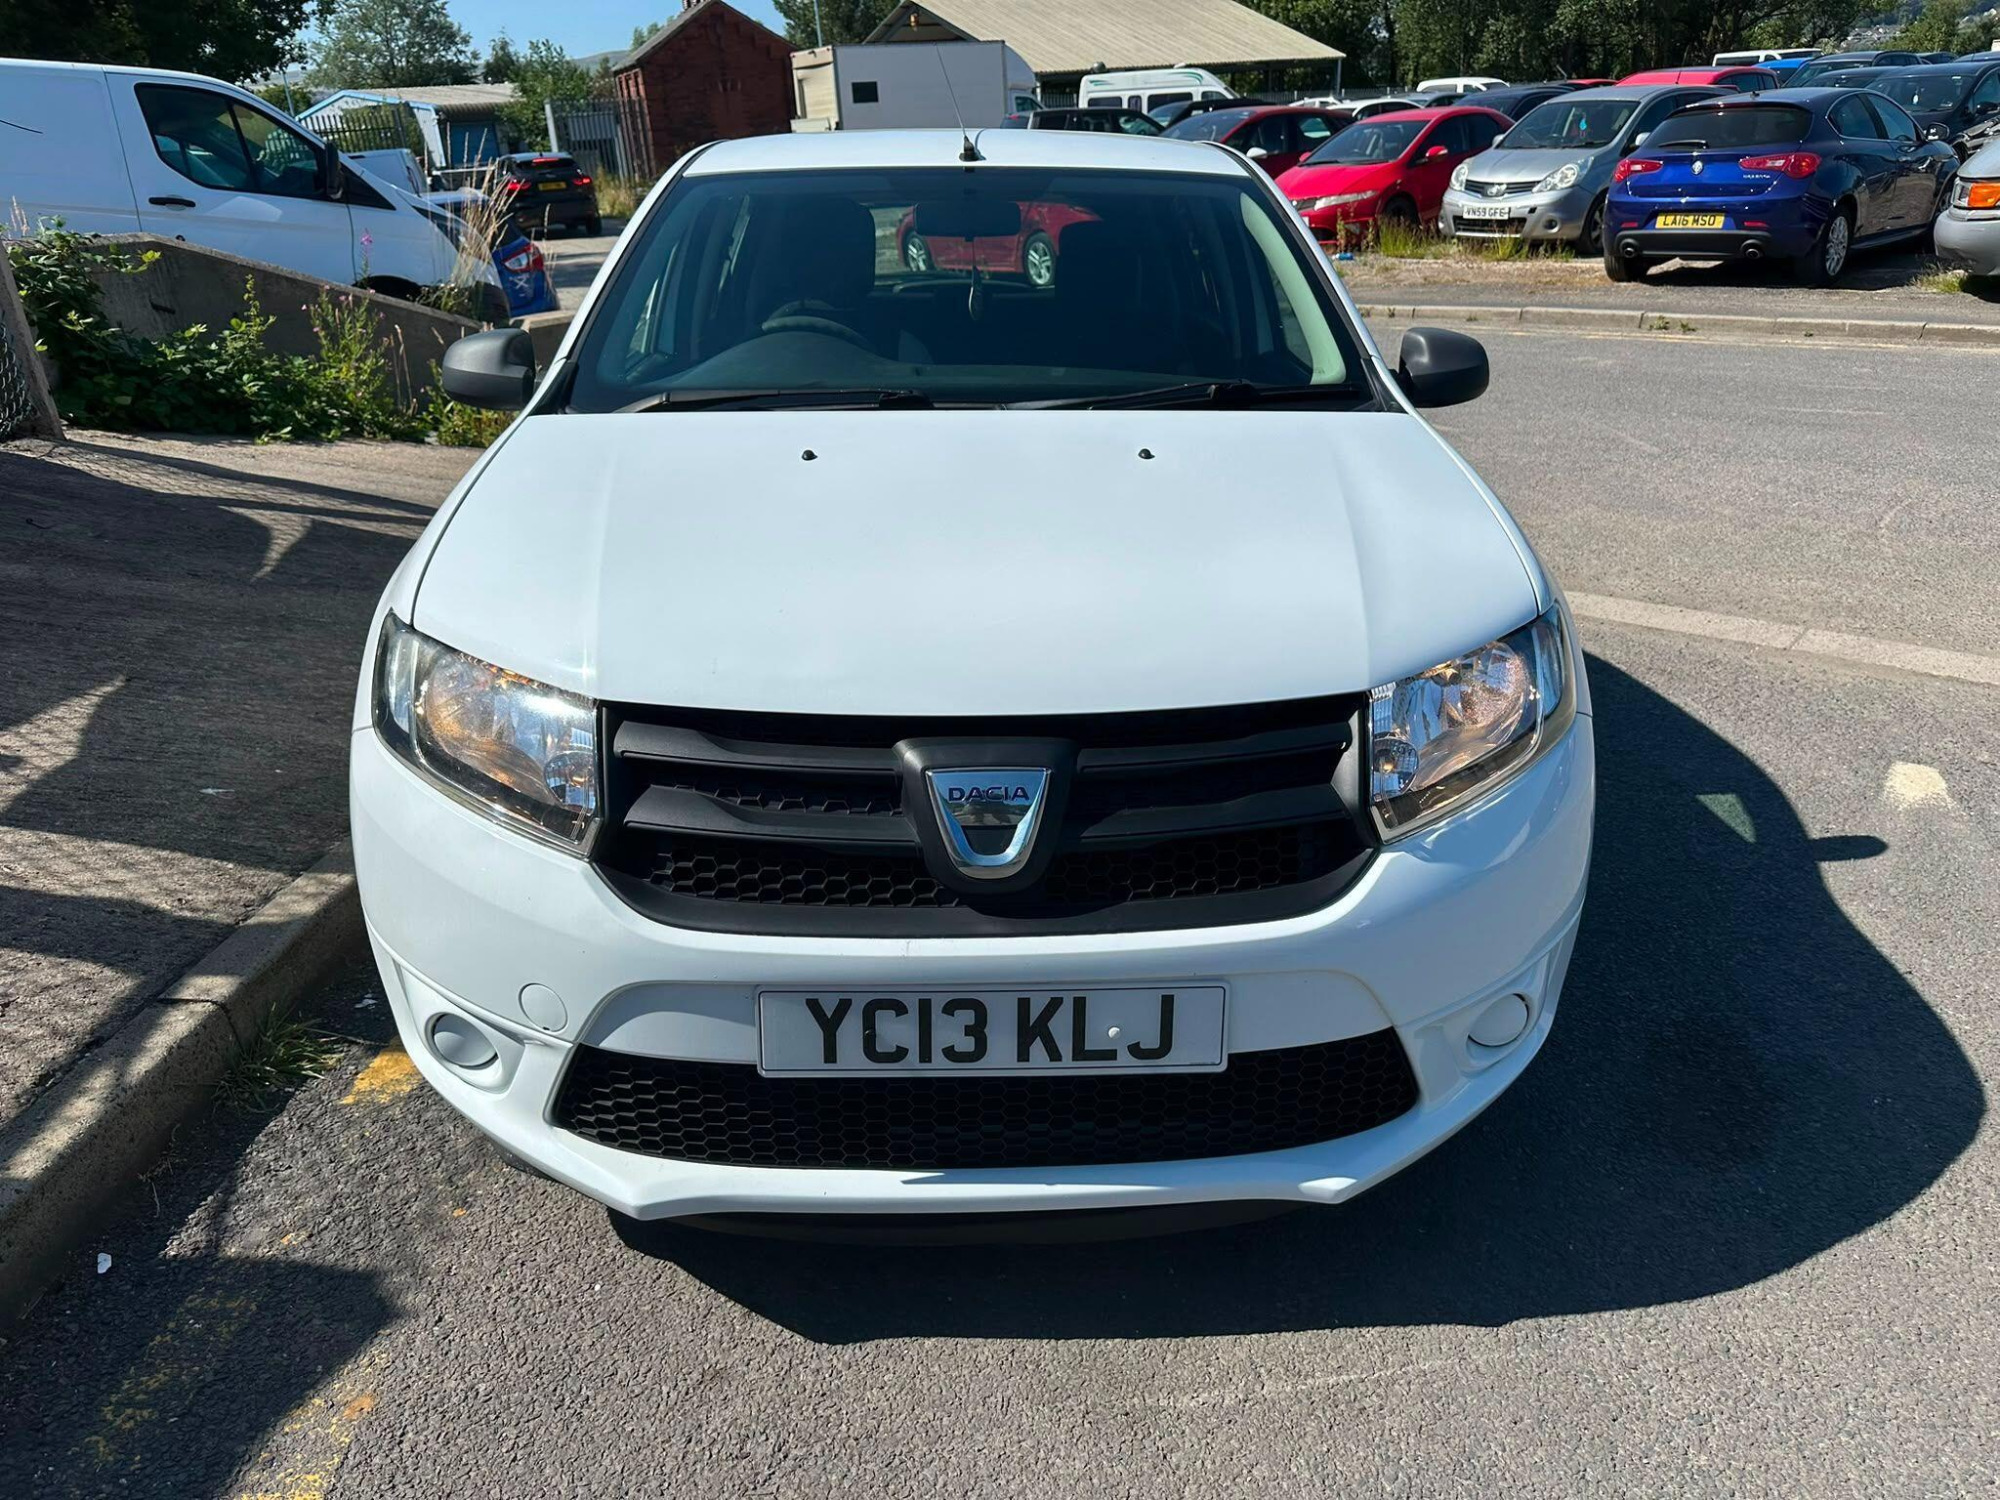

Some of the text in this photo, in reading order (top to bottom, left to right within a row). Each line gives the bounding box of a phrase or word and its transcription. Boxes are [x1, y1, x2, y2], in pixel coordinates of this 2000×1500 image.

[1663, 214, 1689, 226] LA16
[948, 786, 1030, 802] DACIA
[805, 994, 1175, 1064] YC13 KLJ
